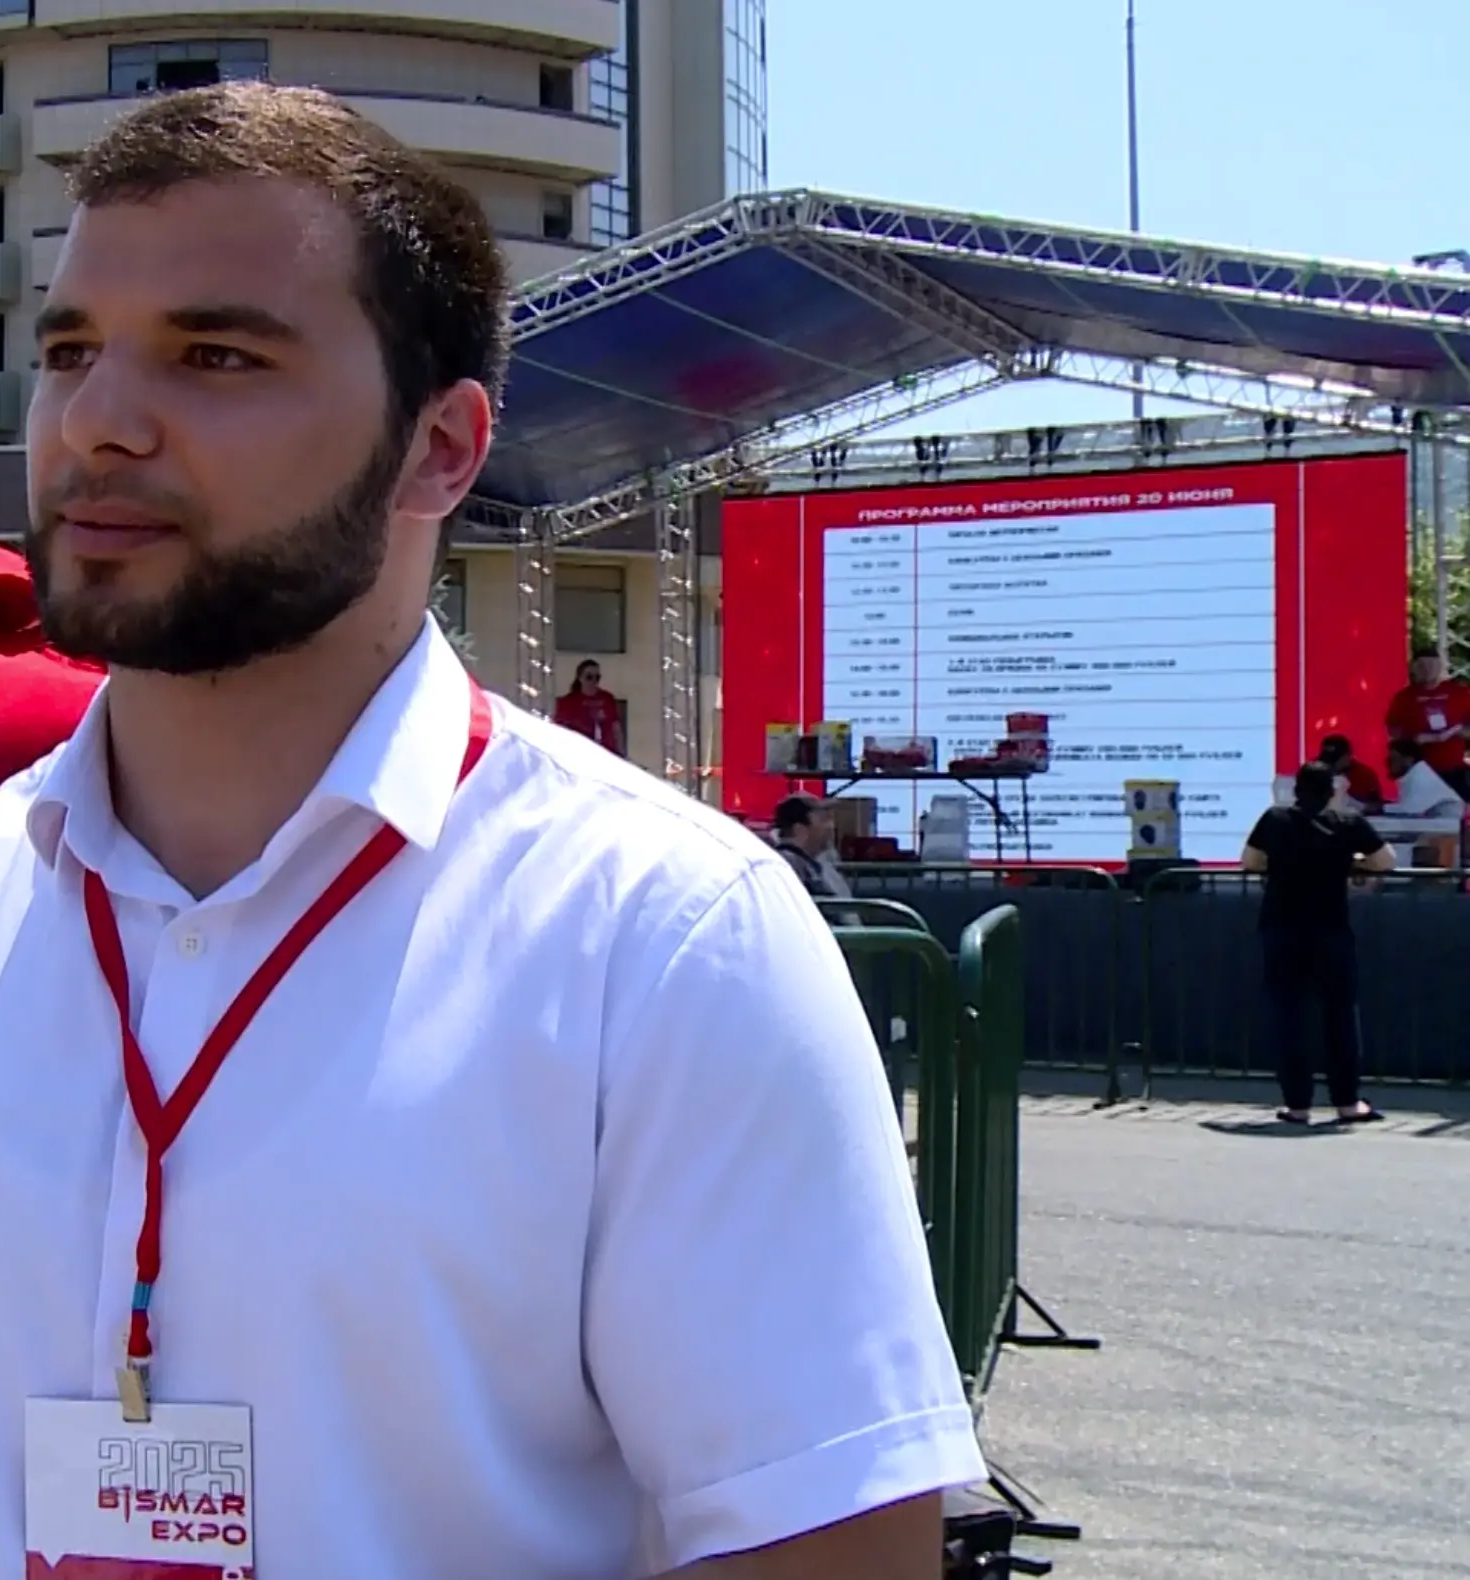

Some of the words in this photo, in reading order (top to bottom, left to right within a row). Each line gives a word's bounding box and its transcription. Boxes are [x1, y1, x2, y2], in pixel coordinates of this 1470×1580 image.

[857, 504, 977, 522] ПРОГРАММА
[982, 494, 1131, 514] МЕРОПРИЯТИЯ
[98, 1438, 246, 1503] 2025
[151, 1519, 248, 1546] EXPO
